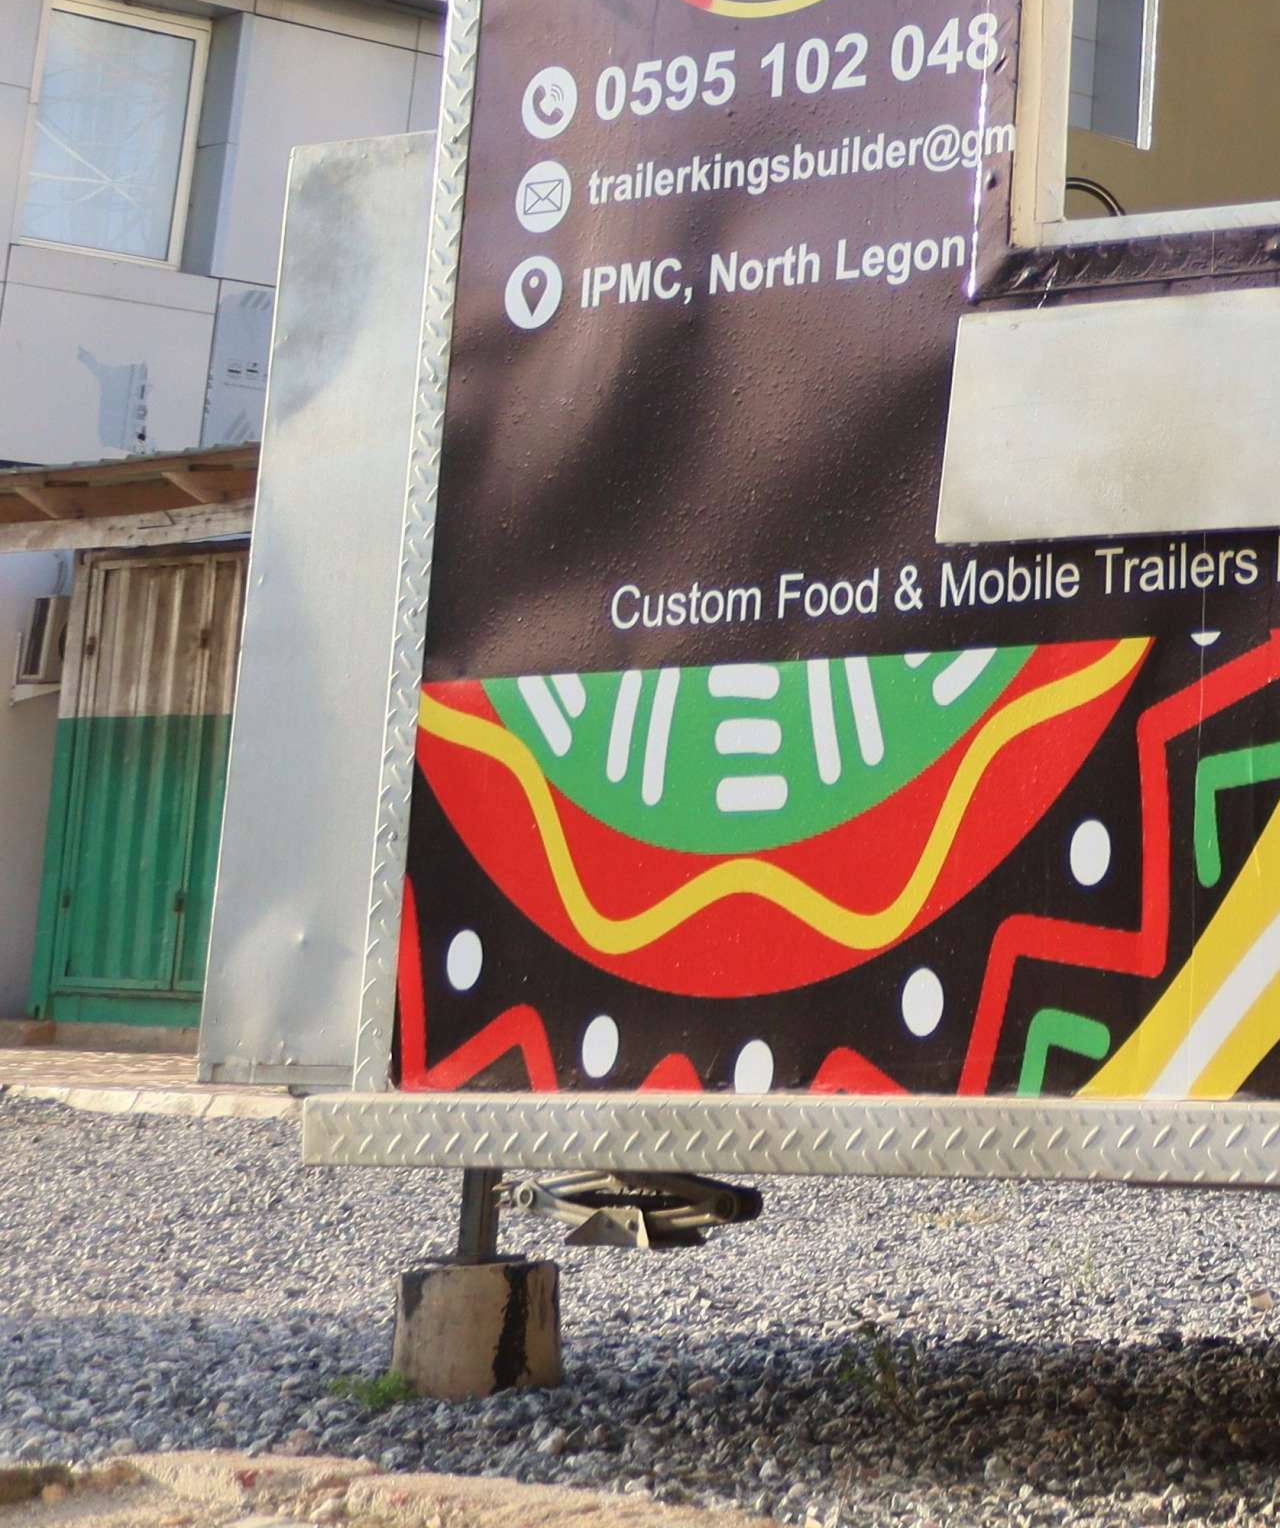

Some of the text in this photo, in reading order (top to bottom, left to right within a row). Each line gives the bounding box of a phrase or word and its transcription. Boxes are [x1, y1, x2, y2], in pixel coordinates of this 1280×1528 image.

[594, 13, 998, 121] 0595 102 048
[588, 123, 1016, 205] trailerkingsbuilder@gm
[580, 234, 966, 309] IPMC, North Legon
[610, 581, 762, 630] Custom
[777, 567, 879, 621] Food
[894, 564, 925, 611] &
[939, 552, 1081, 609] Mobile
[1095, 542, 1258, 595] Trailers
